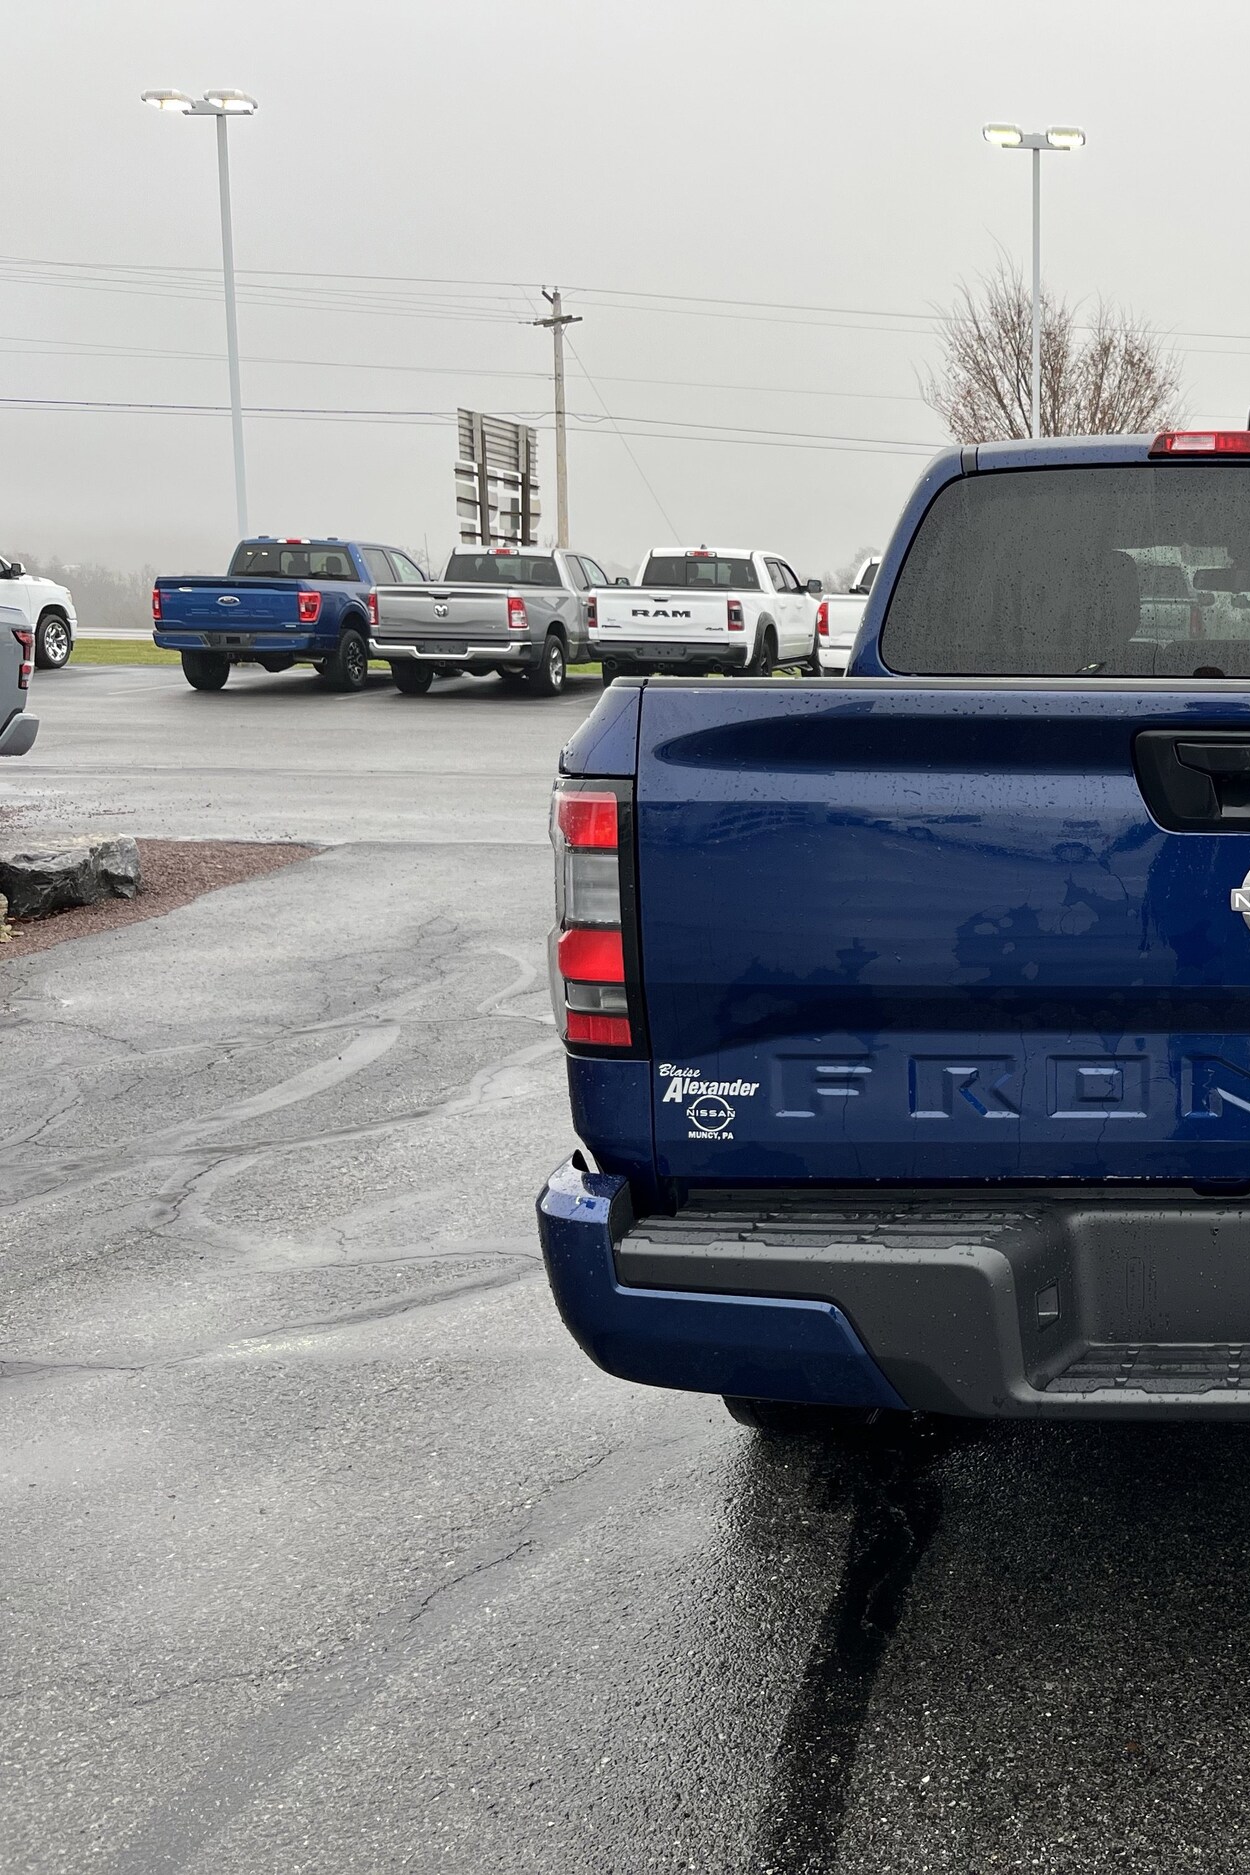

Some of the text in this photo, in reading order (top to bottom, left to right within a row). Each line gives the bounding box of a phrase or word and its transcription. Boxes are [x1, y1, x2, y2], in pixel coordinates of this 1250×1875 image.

[631, 609, 691, 618] RAM
[658, 1063, 701, 1078] Blaise
[662, 1077, 760, 1103] Alexander
[686, 1108, 736, 1118] NISSAN
[688, 1131, 721, 1140] MUNCY,
